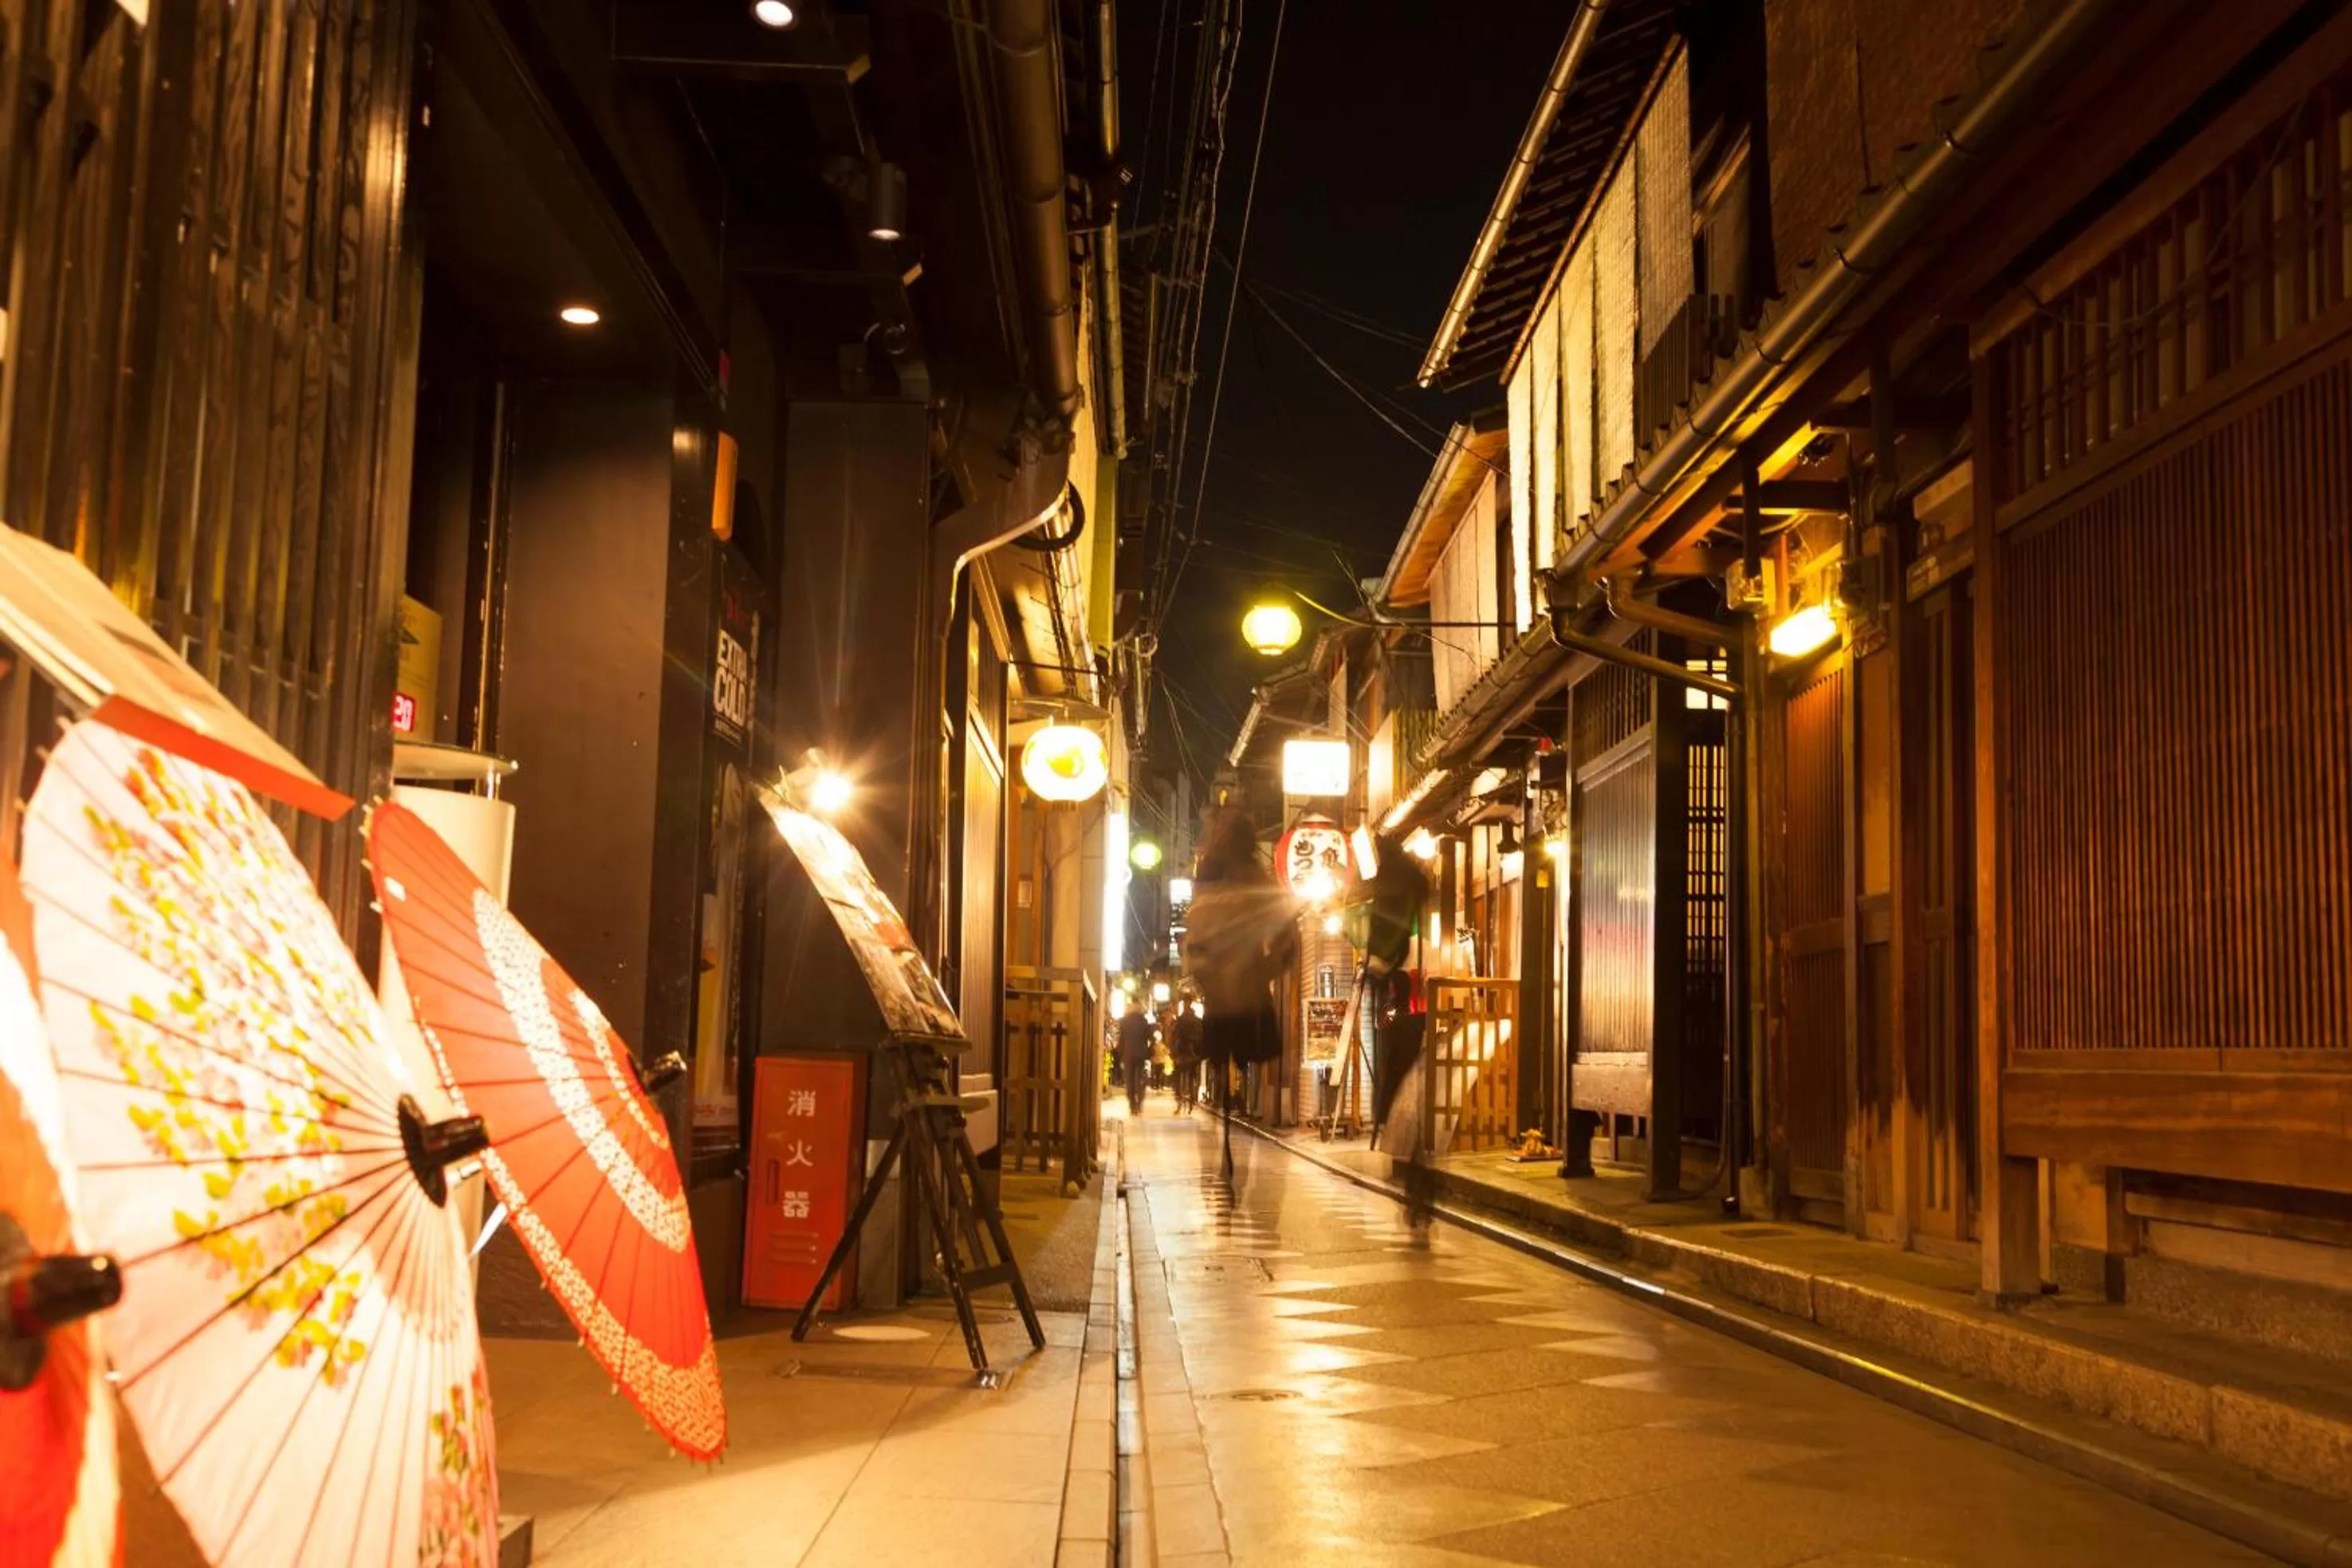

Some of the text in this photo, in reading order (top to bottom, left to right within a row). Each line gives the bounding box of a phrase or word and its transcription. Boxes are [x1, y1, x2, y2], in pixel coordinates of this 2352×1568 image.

[716, 628, 747, 683] EXTRA
[714, 665, 747, 728] COLD
[783, 1090, 816, 1219] 消火器
